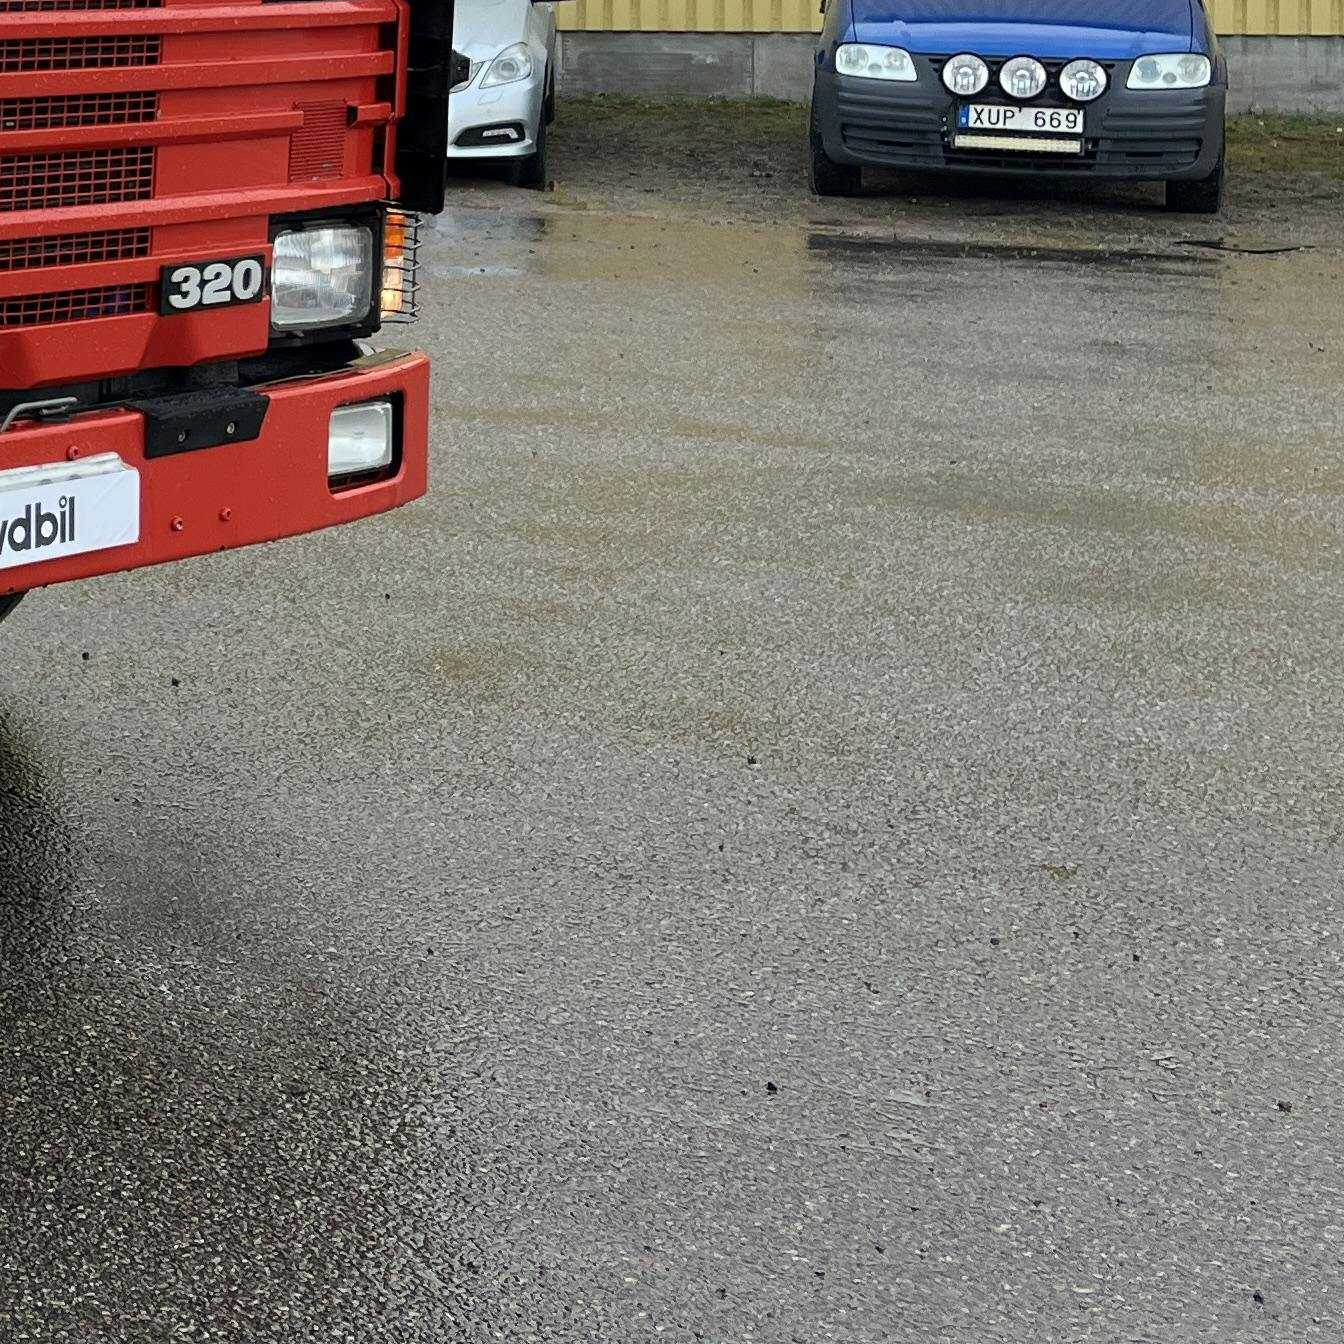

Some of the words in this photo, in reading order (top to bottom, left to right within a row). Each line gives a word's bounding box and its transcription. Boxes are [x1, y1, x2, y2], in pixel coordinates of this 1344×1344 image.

[972, 107, 1015, 126] XUP
[1034, 110, 1077, 129] 669
[169, 259, 262, 309] 320
